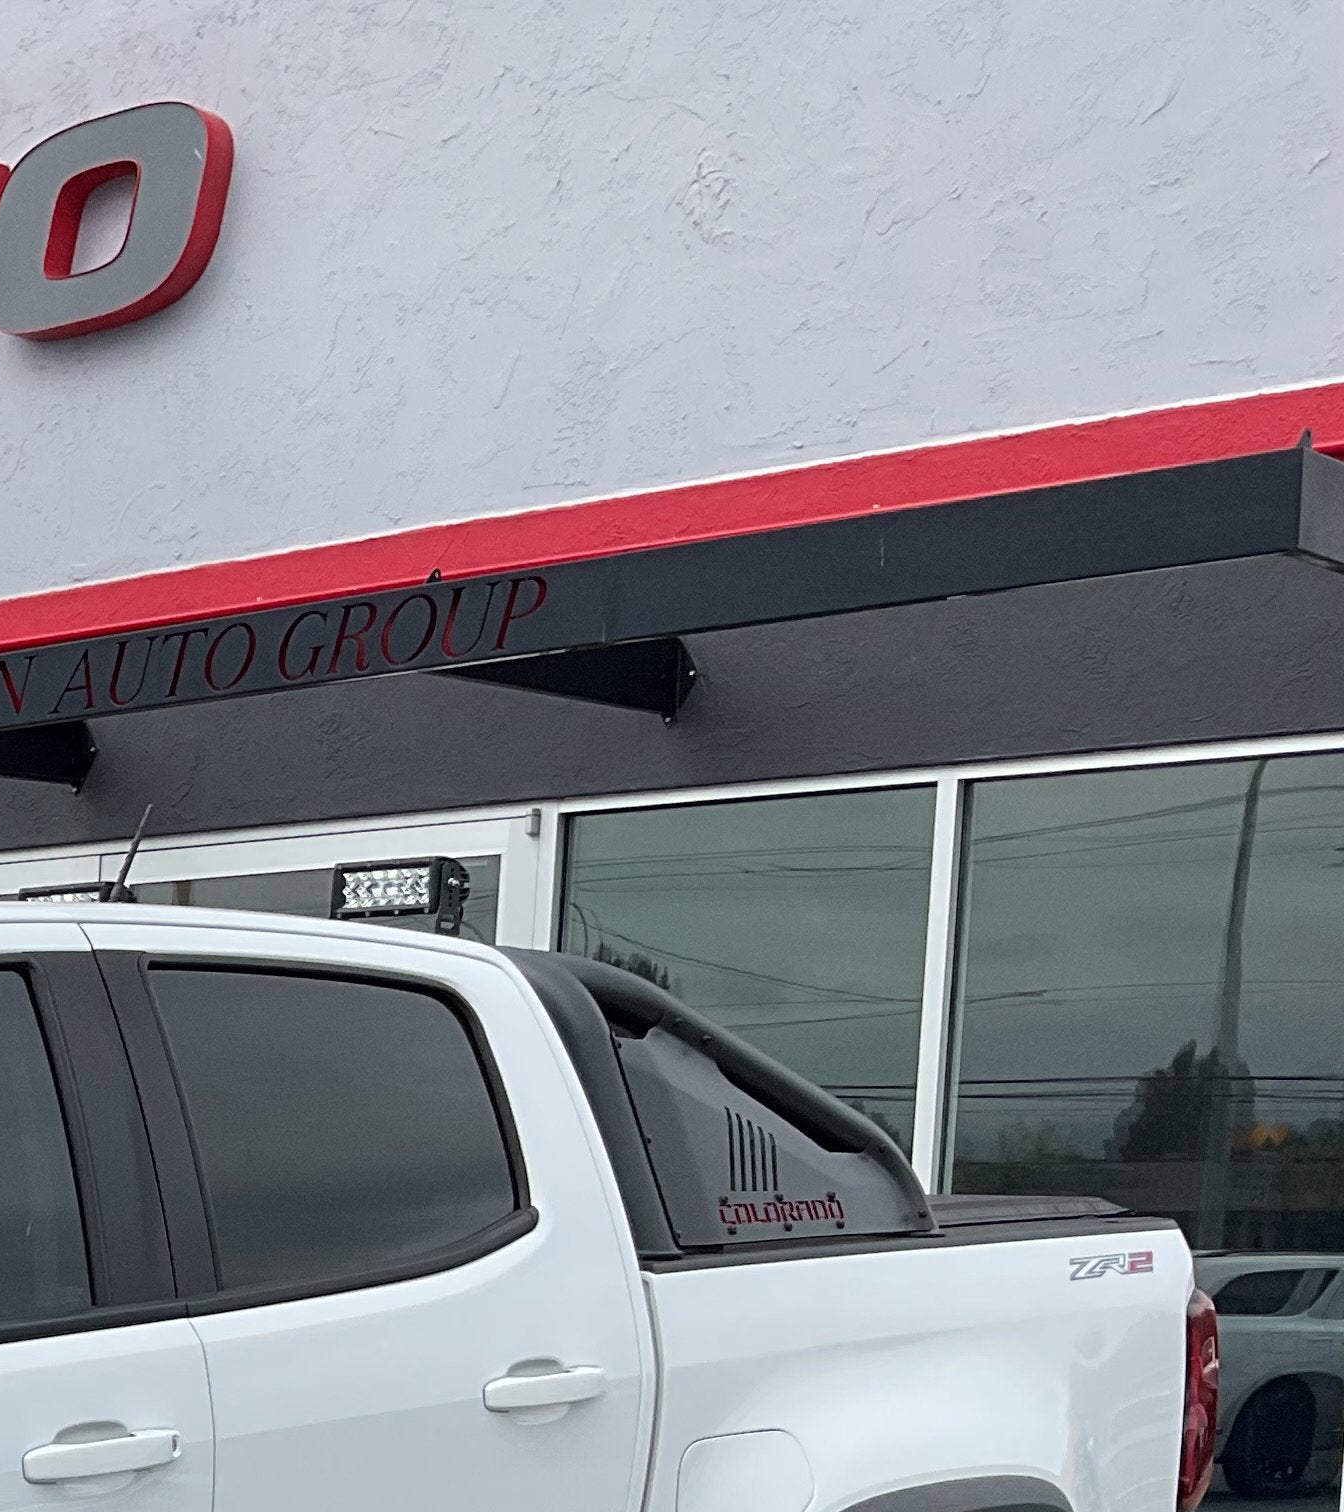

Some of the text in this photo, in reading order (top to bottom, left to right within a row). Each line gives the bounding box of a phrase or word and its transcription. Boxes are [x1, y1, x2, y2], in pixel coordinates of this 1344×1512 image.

[50, 621, 256, 715] AUTO
[278, 575, 548, 681] GROUP
[719, 1199, 844, 1225] COLORADO
[1069, 1250, 1154, 1281] ZR2
